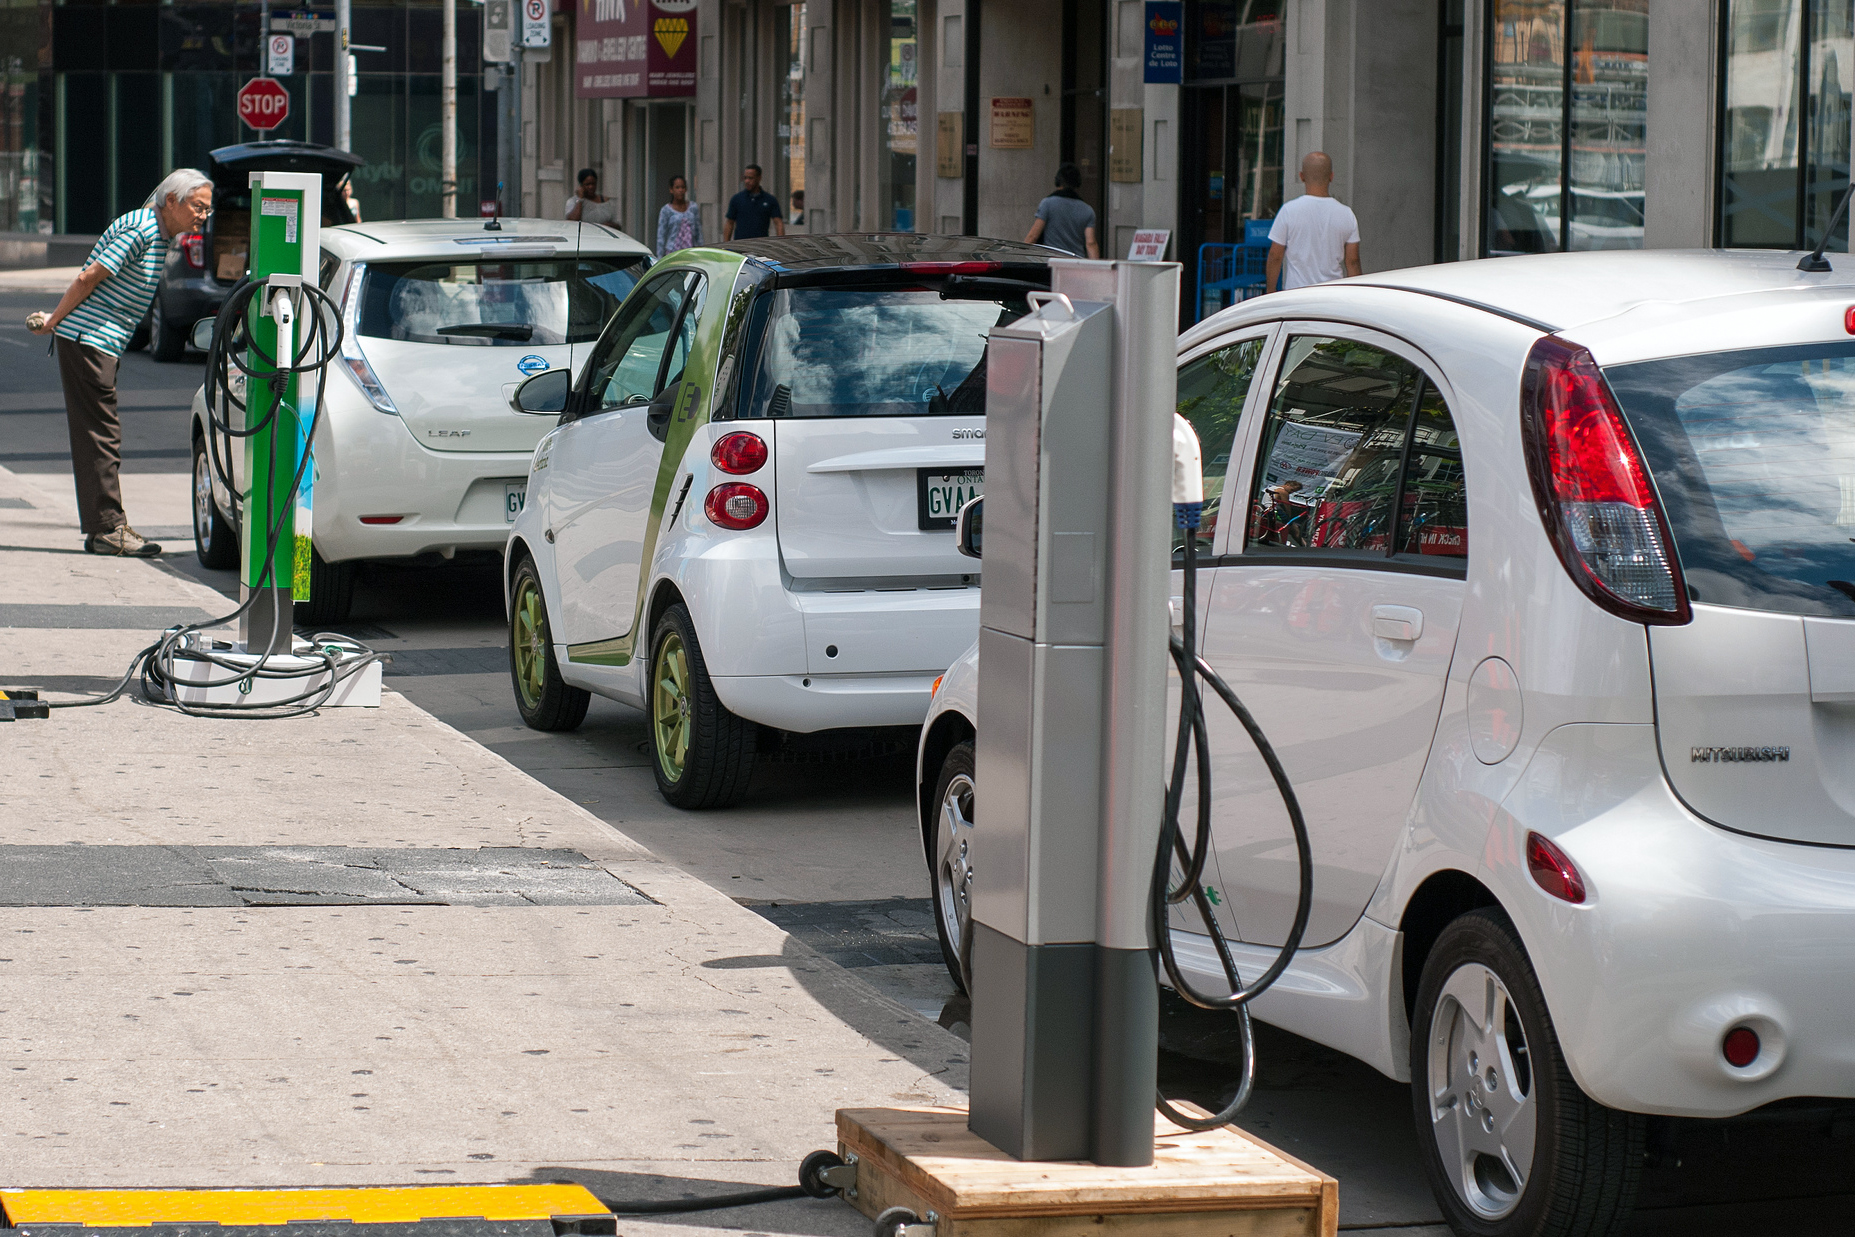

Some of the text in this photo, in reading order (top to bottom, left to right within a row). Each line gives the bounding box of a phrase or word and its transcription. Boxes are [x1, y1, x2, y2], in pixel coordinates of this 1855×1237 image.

[1153, 43, 1174, 51] Lotto
[1151, 51, 1176, 59] Centre
[1148, 59, 1178, 67] de Loto
[241, 93, 286, 115] STOP
[993, 110, 1030, 118] WARNING
[1134, 233, 1167, 243] NIAGARA FALLS
[1135, 245, 1145, 255] DAY
[428, 429, 471, 438] LEAF
[957, 475, 985, 484] ONTA
[507, 492, 526, 512] GV
[1691, 746, 1790, 762] MITSUBISHI
